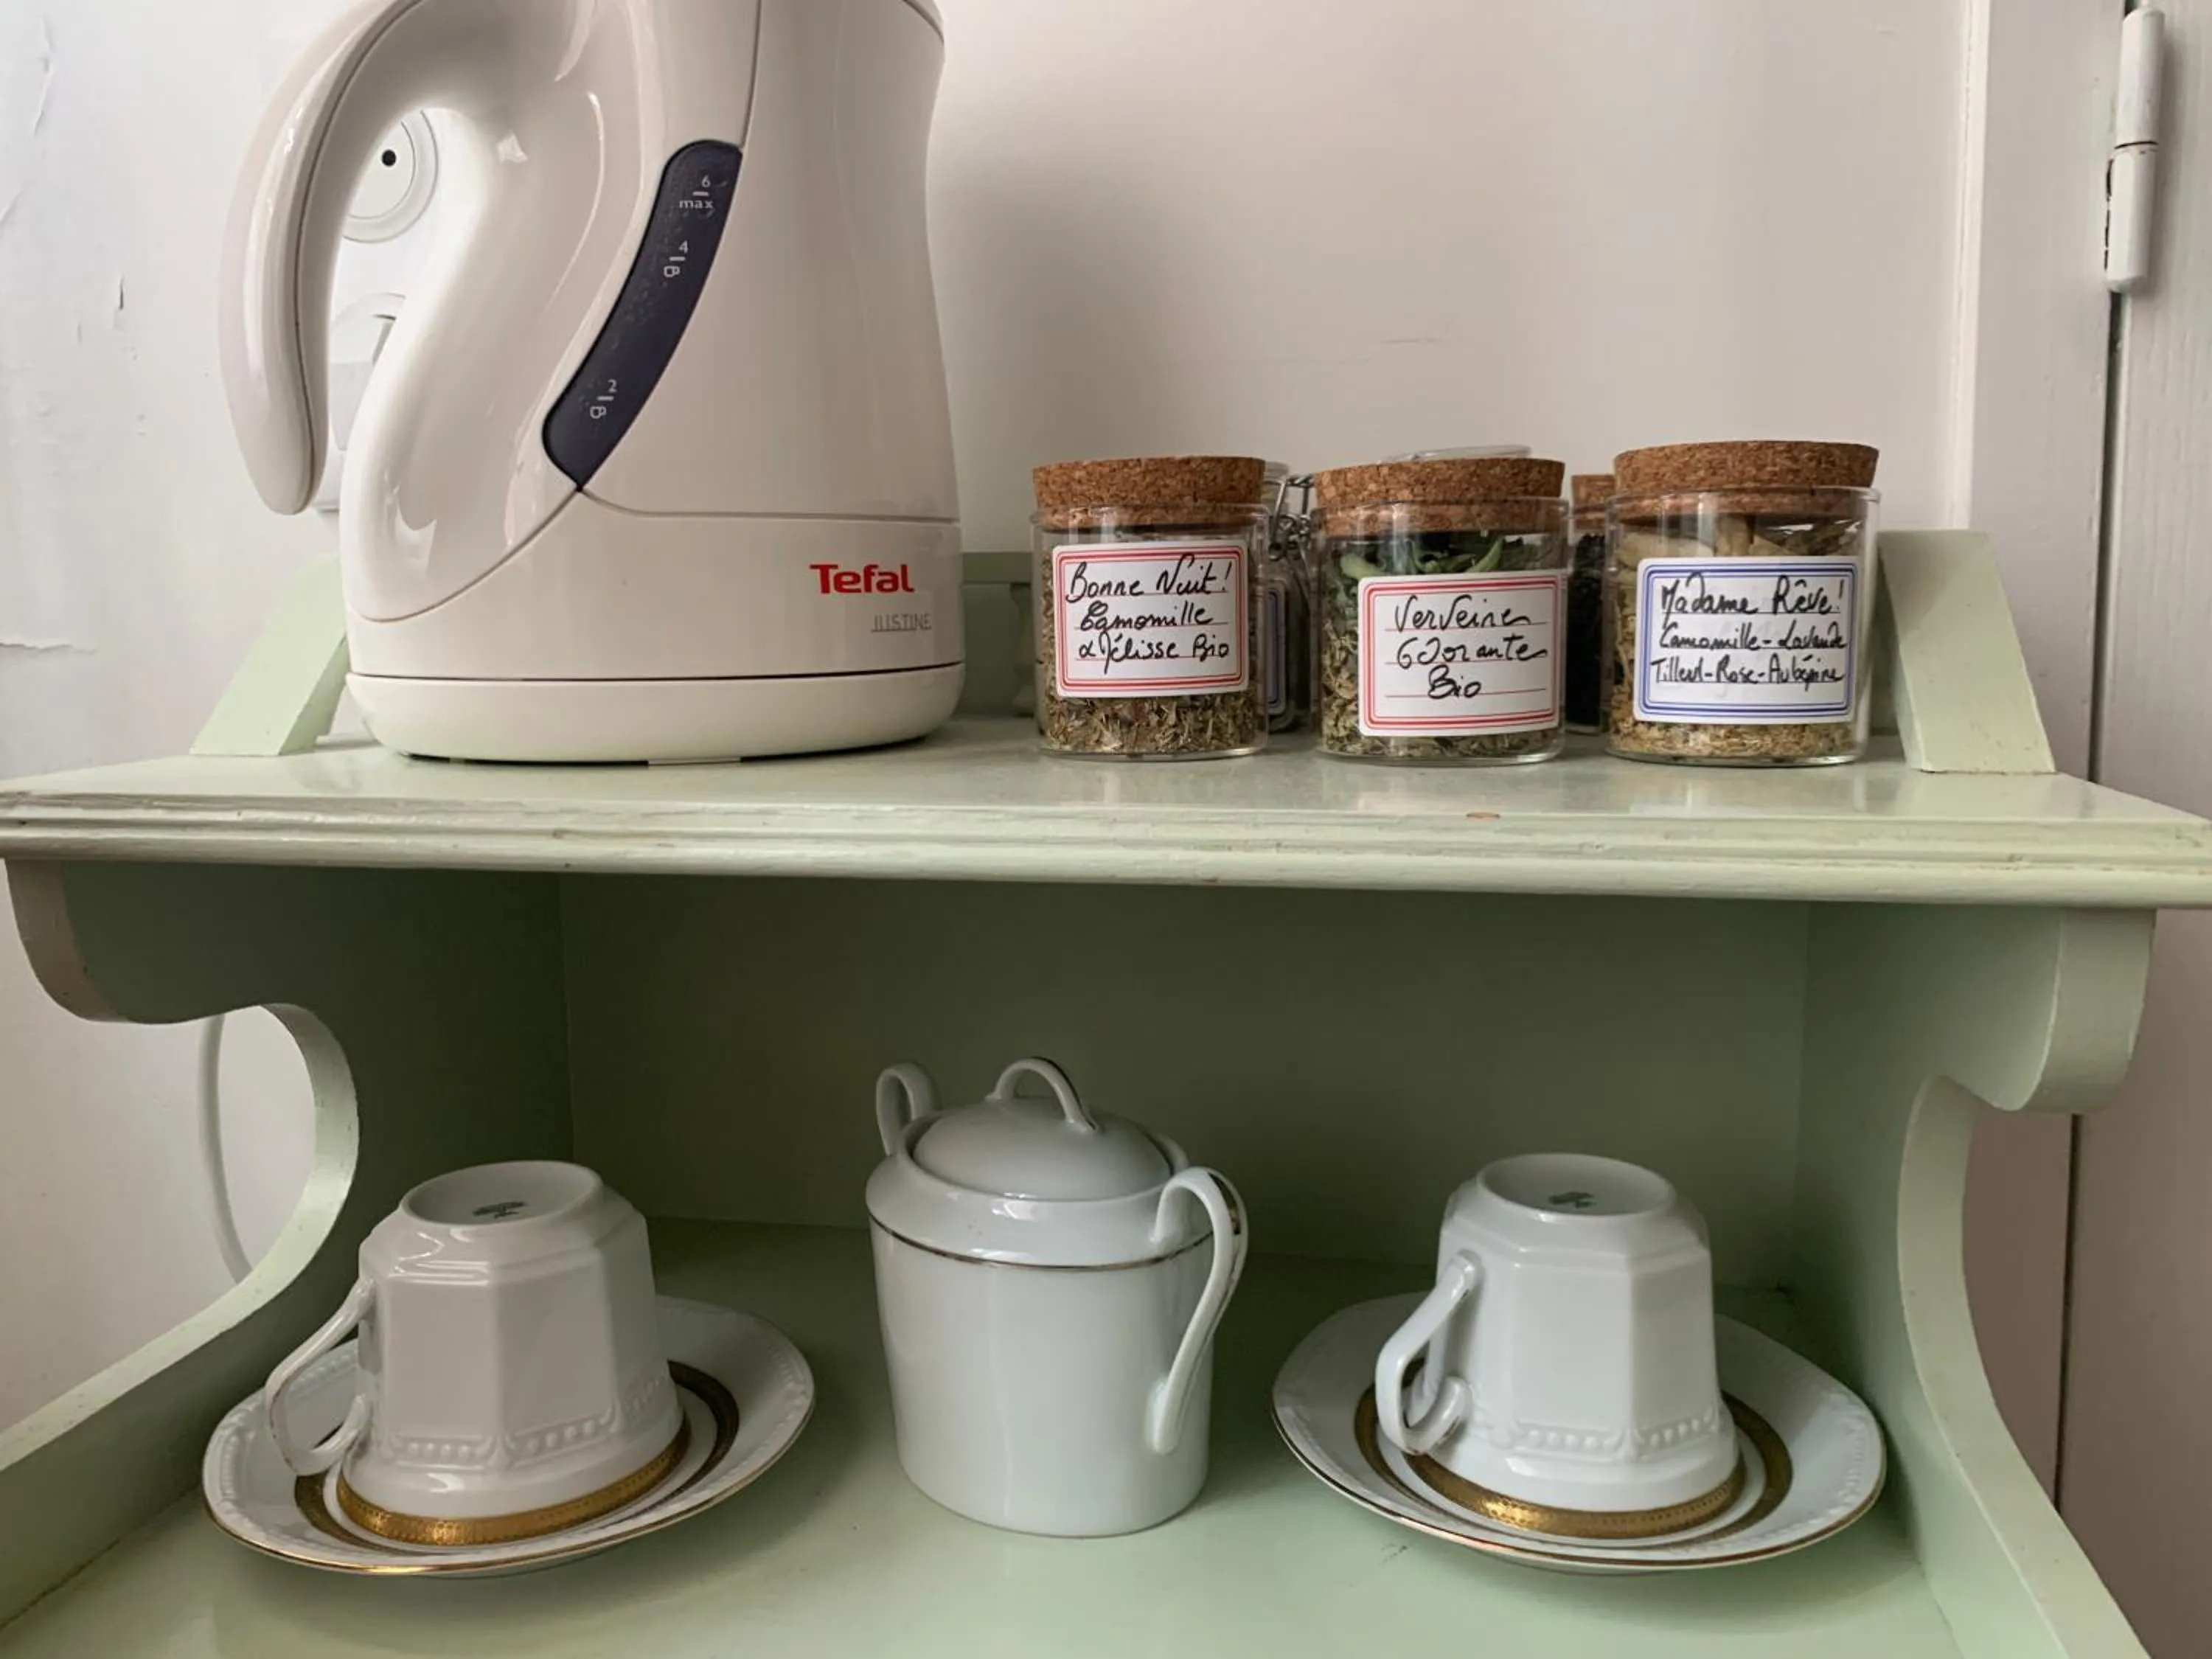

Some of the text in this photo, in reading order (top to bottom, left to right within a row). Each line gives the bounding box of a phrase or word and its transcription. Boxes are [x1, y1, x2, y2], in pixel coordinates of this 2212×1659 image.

[701, 175, 712, 188] 6
[678, 199, 714, 209] max
[678, 240, 689, 254] 4
[607, 378, 618, 393] 2
[809, 563, 916, 594] Tefal
[1065, 561, 1144, 603] Bonne
[1660, 571, 1759, 629] Madame
[1079, 599, 1214, 633] Camomille
[1191, 633, 1230, 663] Bio
[1427, 664, 1482, 700] Bio
